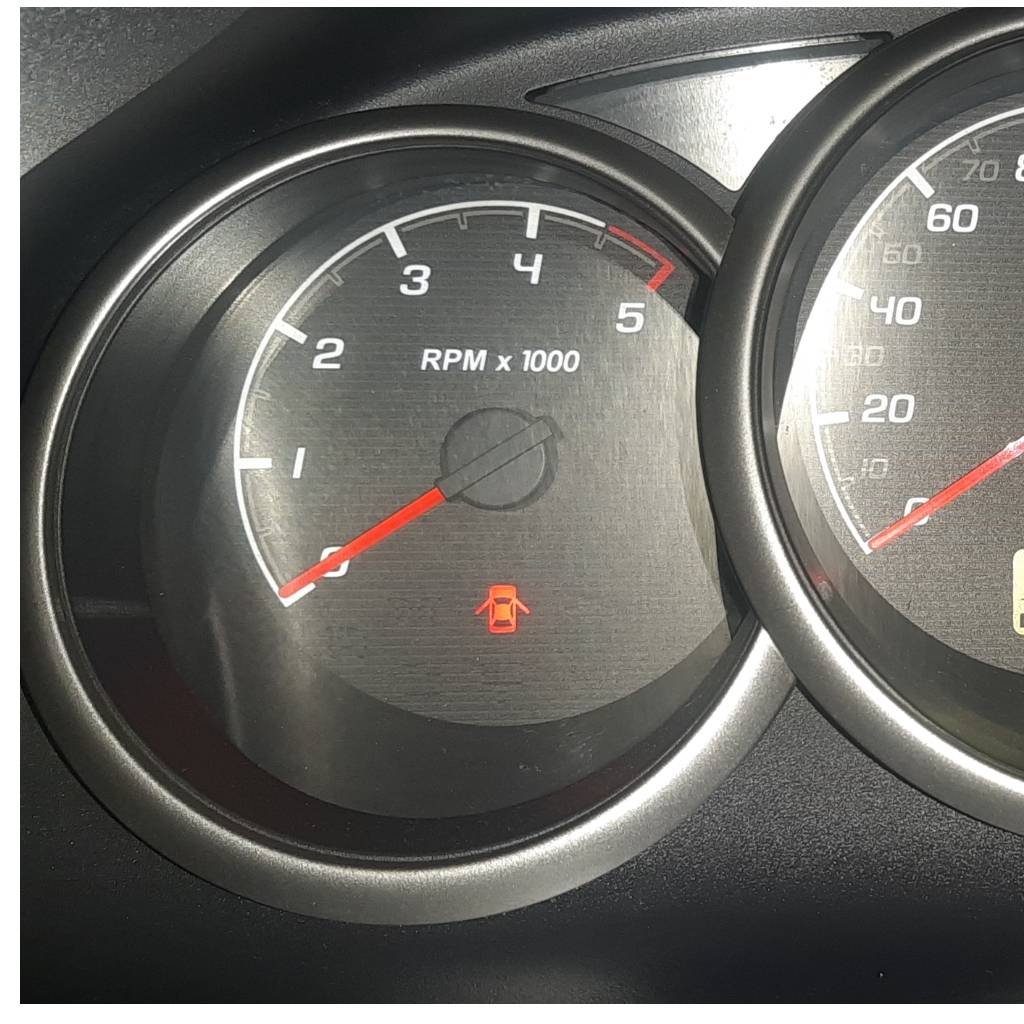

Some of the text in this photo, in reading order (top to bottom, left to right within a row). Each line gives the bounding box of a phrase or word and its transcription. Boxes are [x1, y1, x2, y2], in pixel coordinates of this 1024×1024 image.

[962, 159, 1000, 182] 70
[926, 203, 979, 233] 60
[399, 264, 432, 296] 3
[513, 253, 543, 285] 4
[615, 302, 646, 334] 5
[870, 295, 923, 326] 40
[312, 337, 345, 370] 2
[420, 348, 581, 373] RPM x 1000
[861, 393, 915, 424] 20
[293, 447, 306, 479] 1
